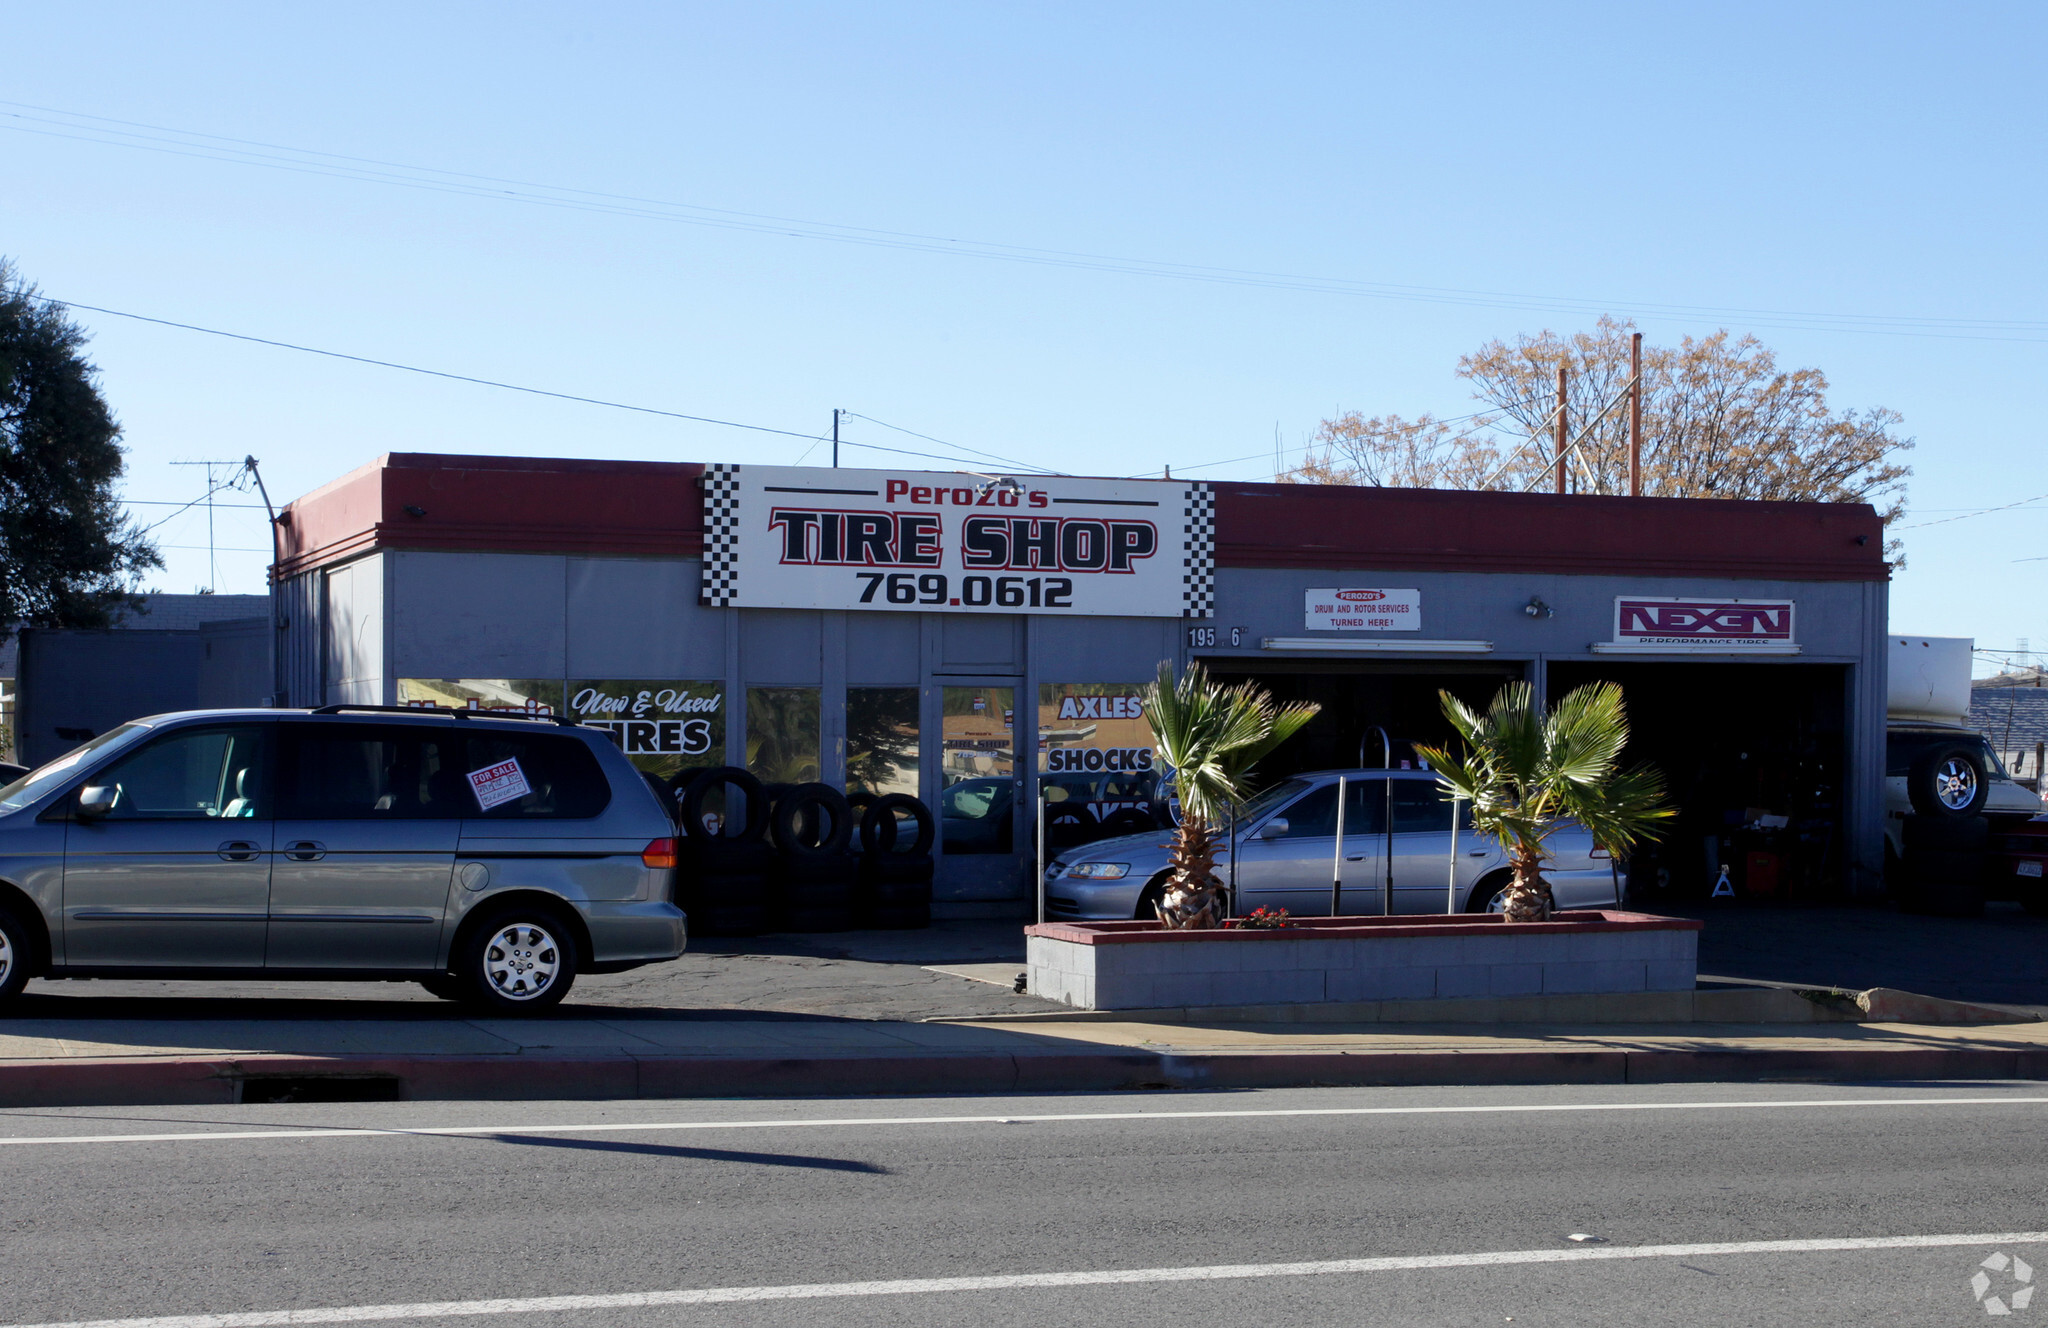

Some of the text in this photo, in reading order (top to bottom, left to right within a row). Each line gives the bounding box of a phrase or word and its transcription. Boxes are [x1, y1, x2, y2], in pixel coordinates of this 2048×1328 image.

[886, 480, 1048, 509] Perozo's
[768, 506, 1158, 575] TIRE SHOP
[856, 572, 1073, 607] 769.0612
[1340, 592, 1381, 600] PEROZO'S
[1315, 605, 1410, 613] DRUM AND ROTOR SERVICES
[1620, 606, 1790, 633] NEXEN
[1189, 628, 1215, 647] 195
[571, 688, 630, 715] New
[632, 690, 652, 718] &
[655, 689, 721, 713] Used
[1057, 696, 1143, 720] AXLES
[1048, 747, 1152, 773] SHOCKS
[473, 771, 493, 784] FOR
[492, 763, 516, 777] SALE
